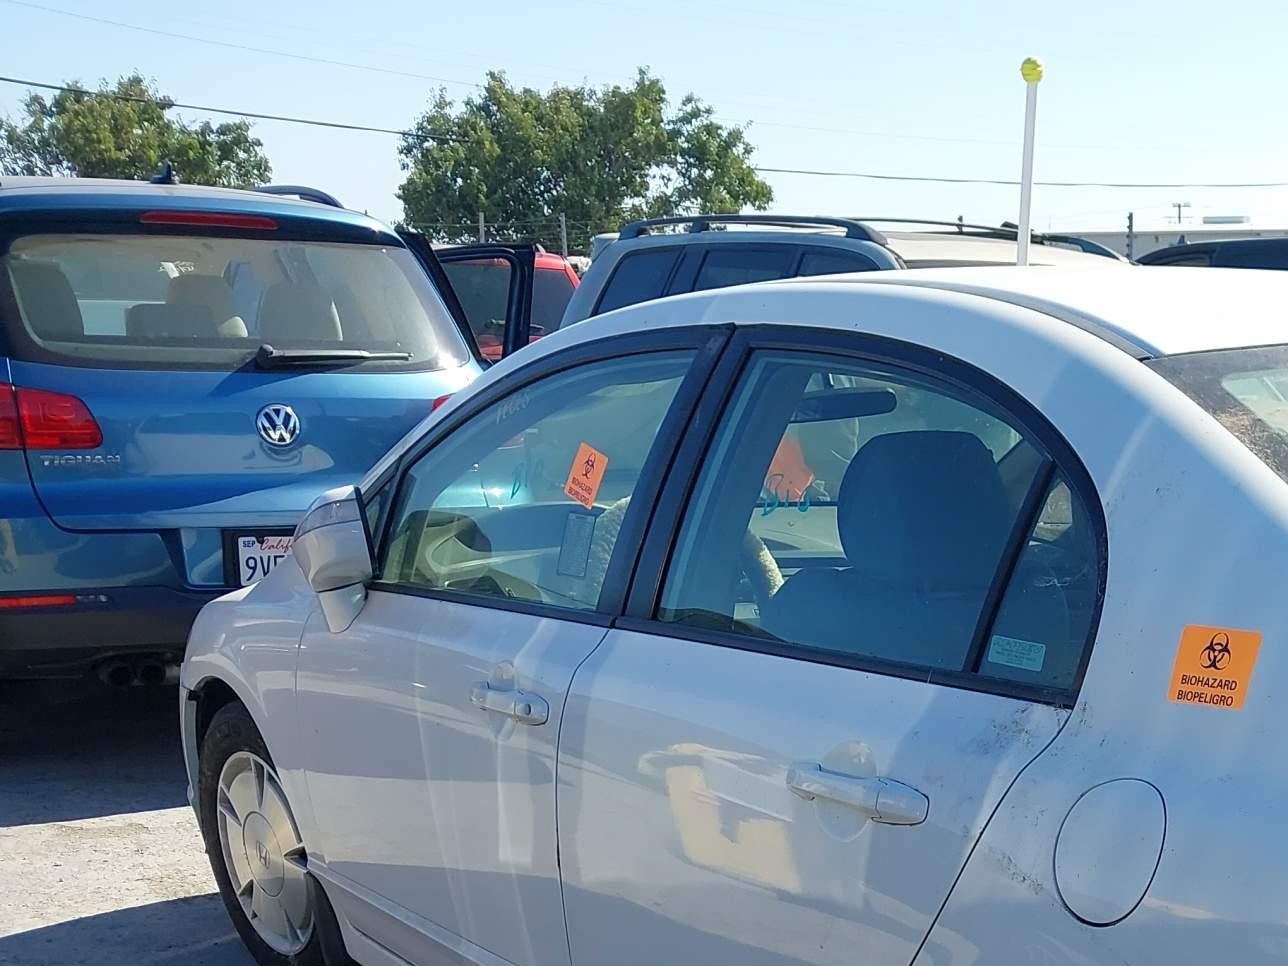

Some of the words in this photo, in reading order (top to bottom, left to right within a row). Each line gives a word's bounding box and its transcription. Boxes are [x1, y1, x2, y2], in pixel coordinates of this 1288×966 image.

[40, 454, 121, 467] TIGUAN
[242, 540, 256, 548] SEP
[1180, 674, 1238, 691] BIOHAZARD
[1176, 689, 1234, 707] BIOPELIGRO
